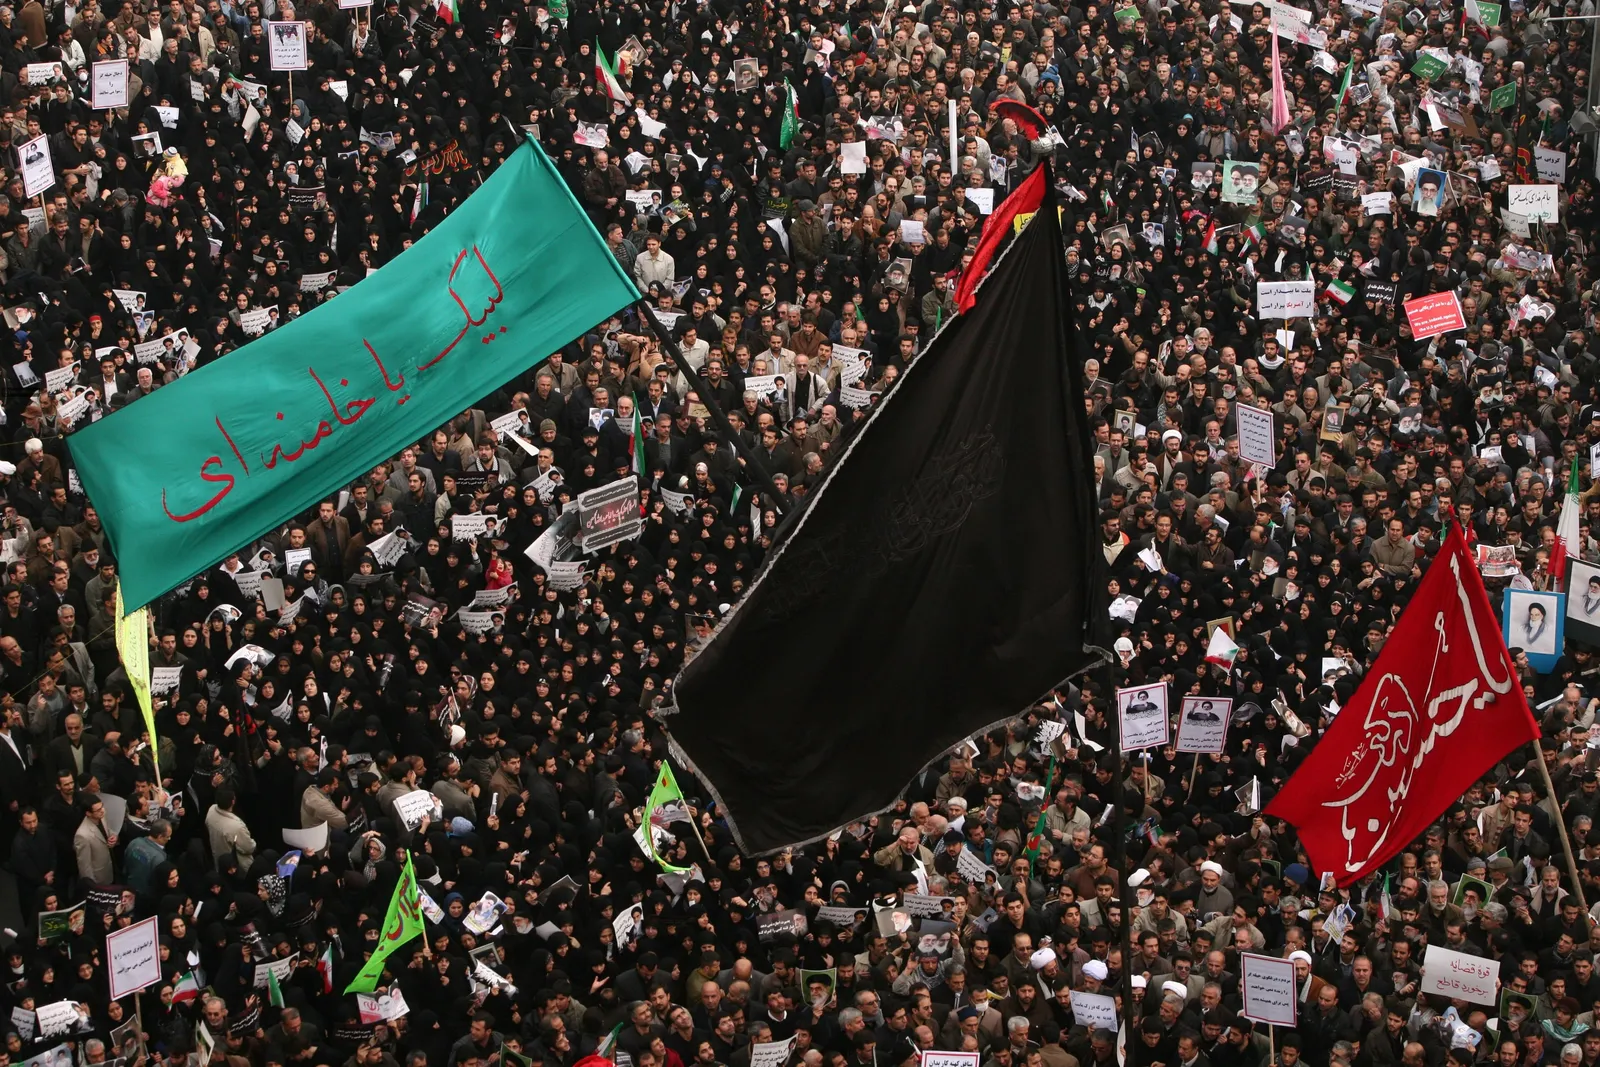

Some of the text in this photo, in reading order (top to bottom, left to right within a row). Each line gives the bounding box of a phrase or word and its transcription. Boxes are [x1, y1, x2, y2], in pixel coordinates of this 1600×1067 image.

[162, 244, 507, 523] لبیک یا خامنه ای
[1450, 551, 1513, 709] یا
[1436, 976, 1488, 998] برخورد قاطع
